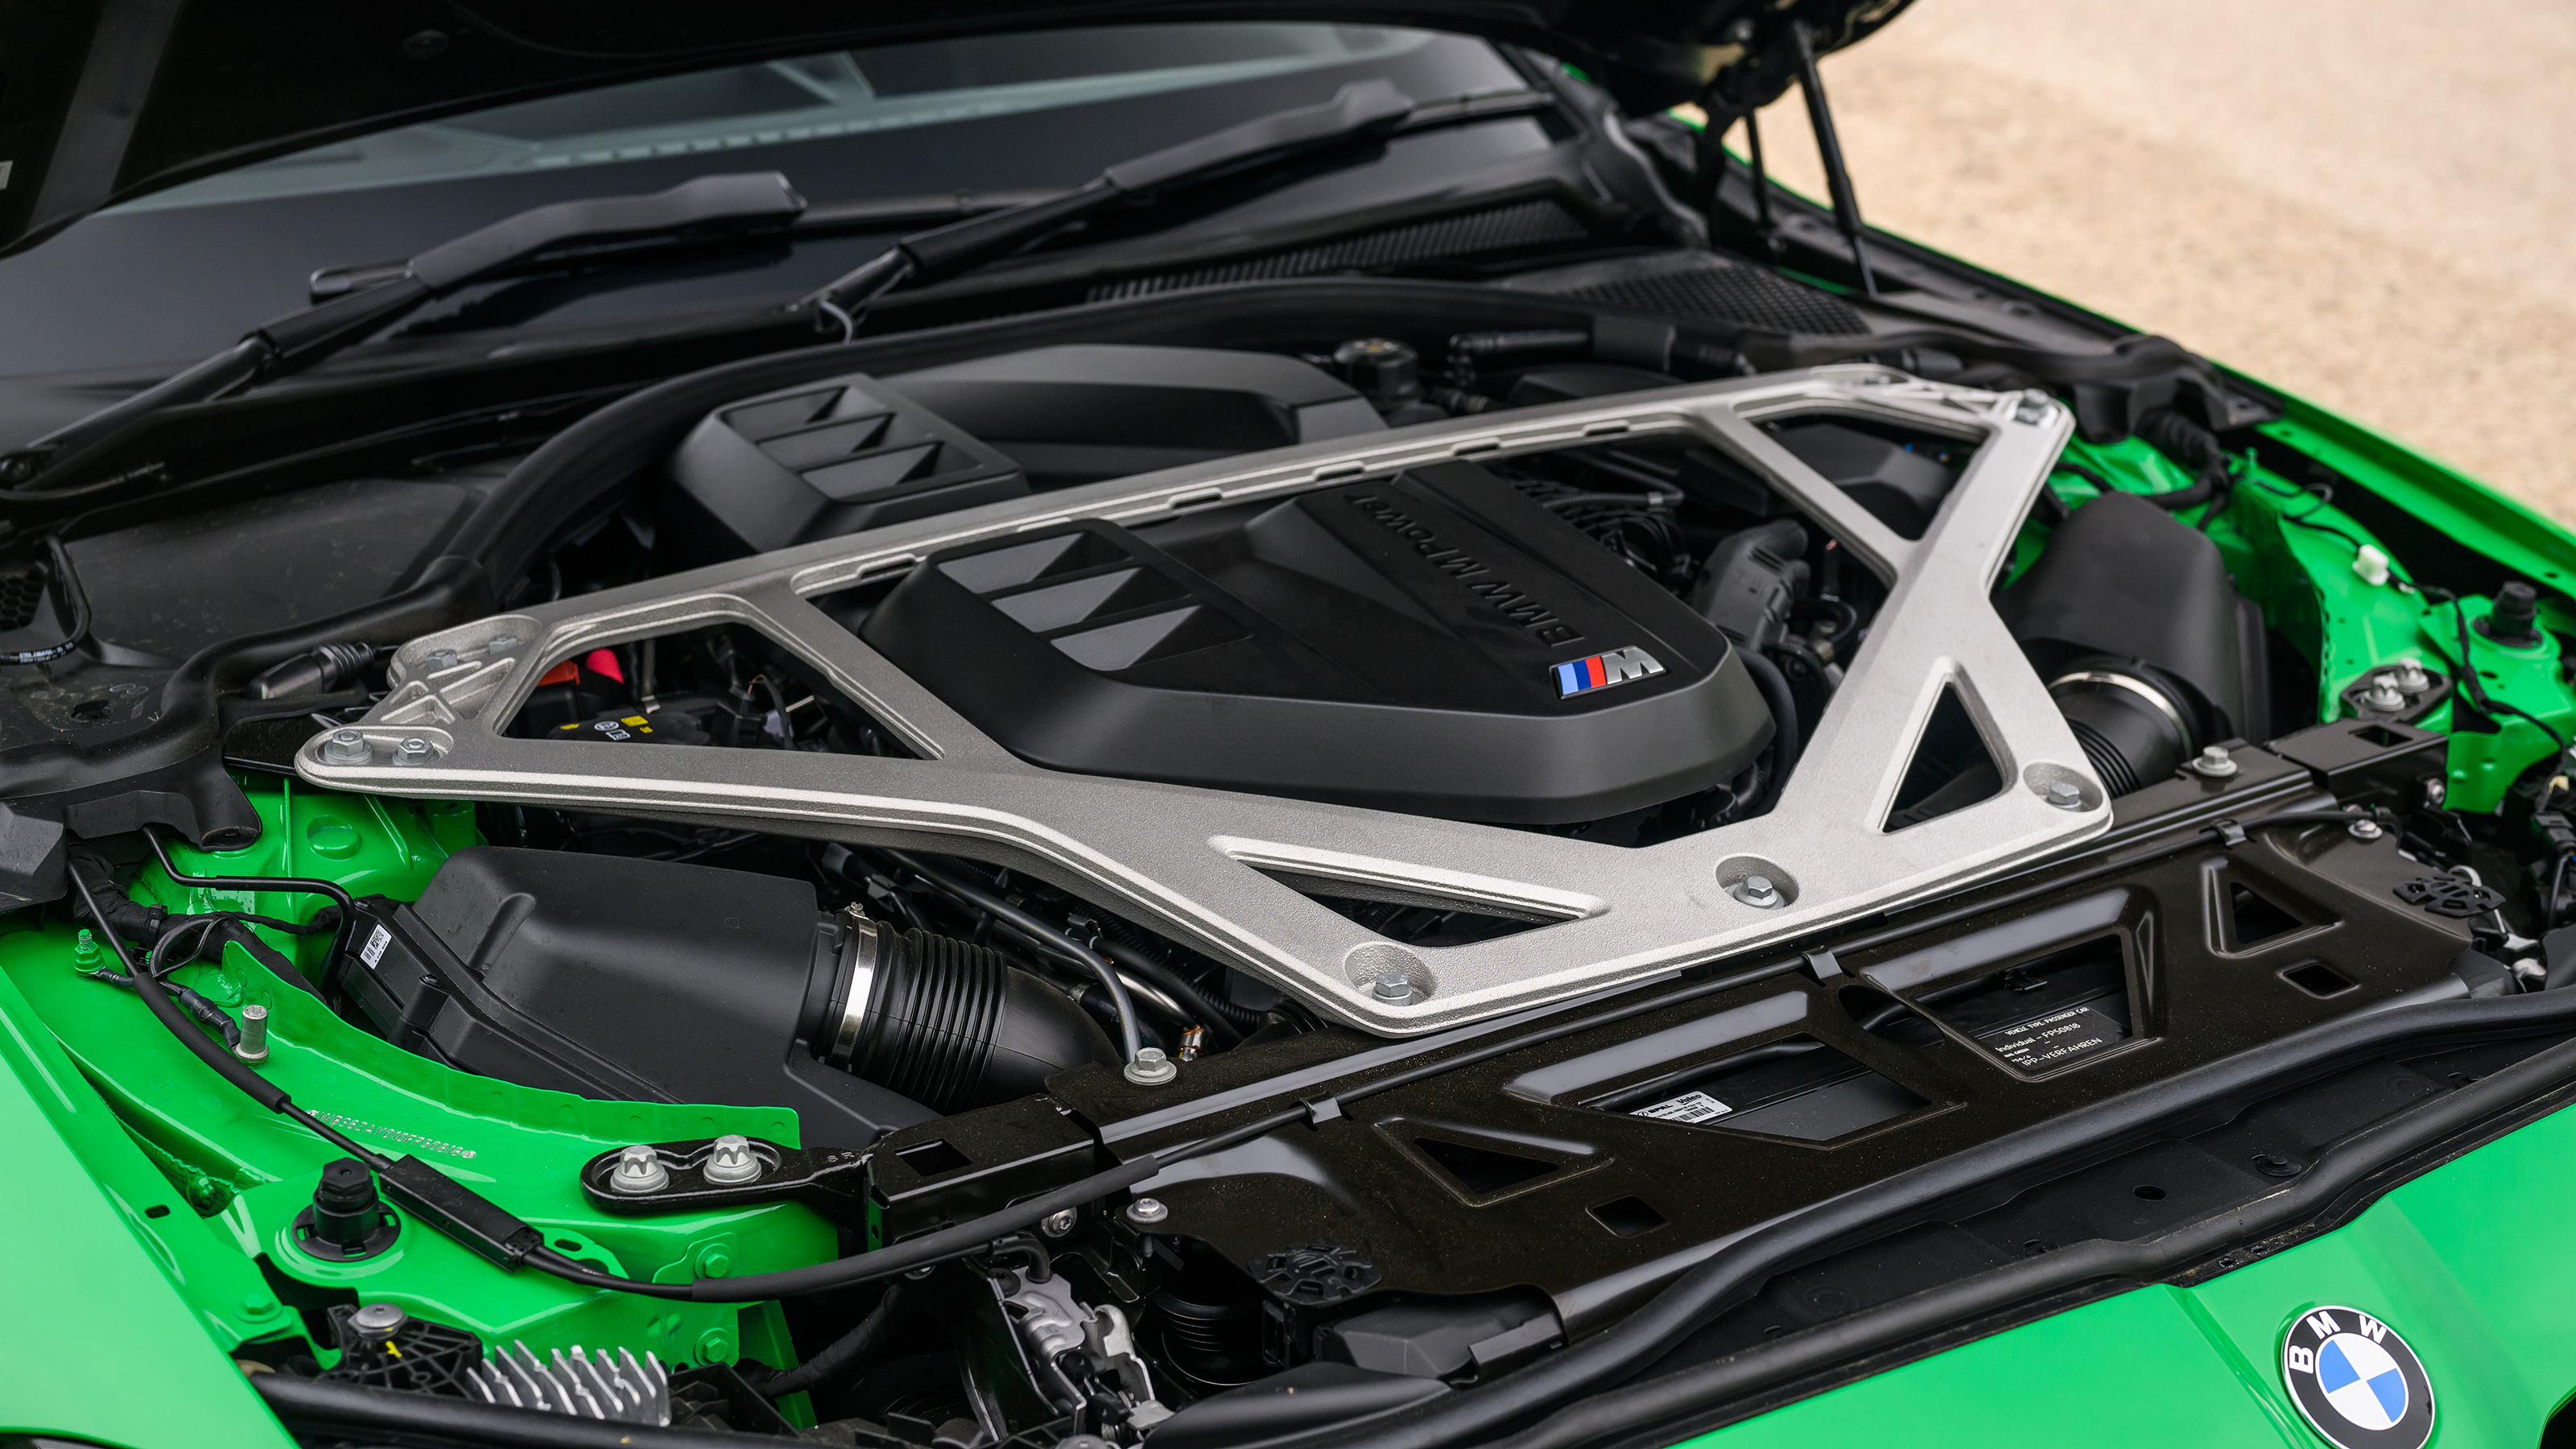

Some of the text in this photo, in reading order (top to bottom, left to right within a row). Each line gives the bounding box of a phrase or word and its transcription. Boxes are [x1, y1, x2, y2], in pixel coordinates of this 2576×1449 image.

[1469, 580, 1585, 647] BMW
[1600, 646, 1665, 686] M
[1995, 1037, 2037, 1053] Individual
[2041, 1022, 2081, 1038] FP50818
[1676, 1094, 1703, 1104] Valeo
[2289, 1310, 2388, 1375] BMW
